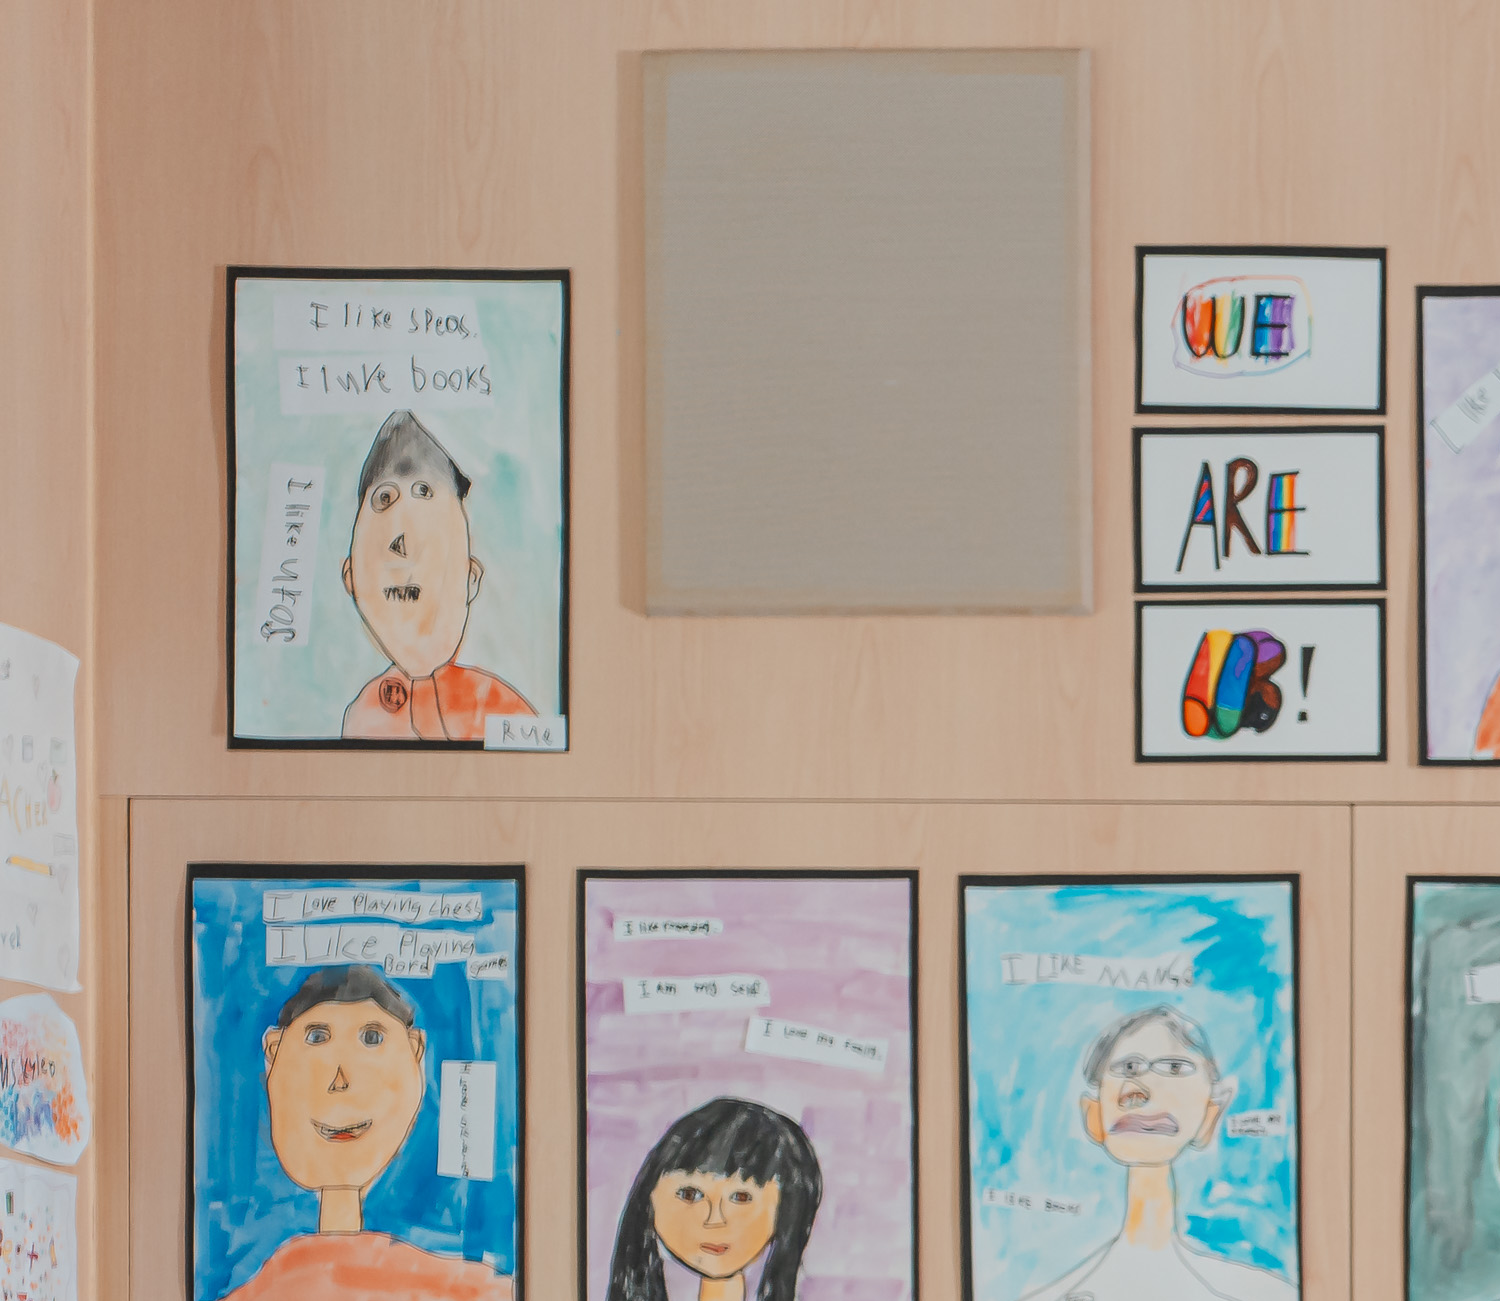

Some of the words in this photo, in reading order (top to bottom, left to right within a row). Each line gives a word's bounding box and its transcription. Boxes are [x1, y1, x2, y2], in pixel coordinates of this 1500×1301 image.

[1184, 294, 1297, 359] WE
[1175, 456, 1311, 573] ARE
[269, 894, 286, 922] I
[1003, 954, 1023, 985] I
